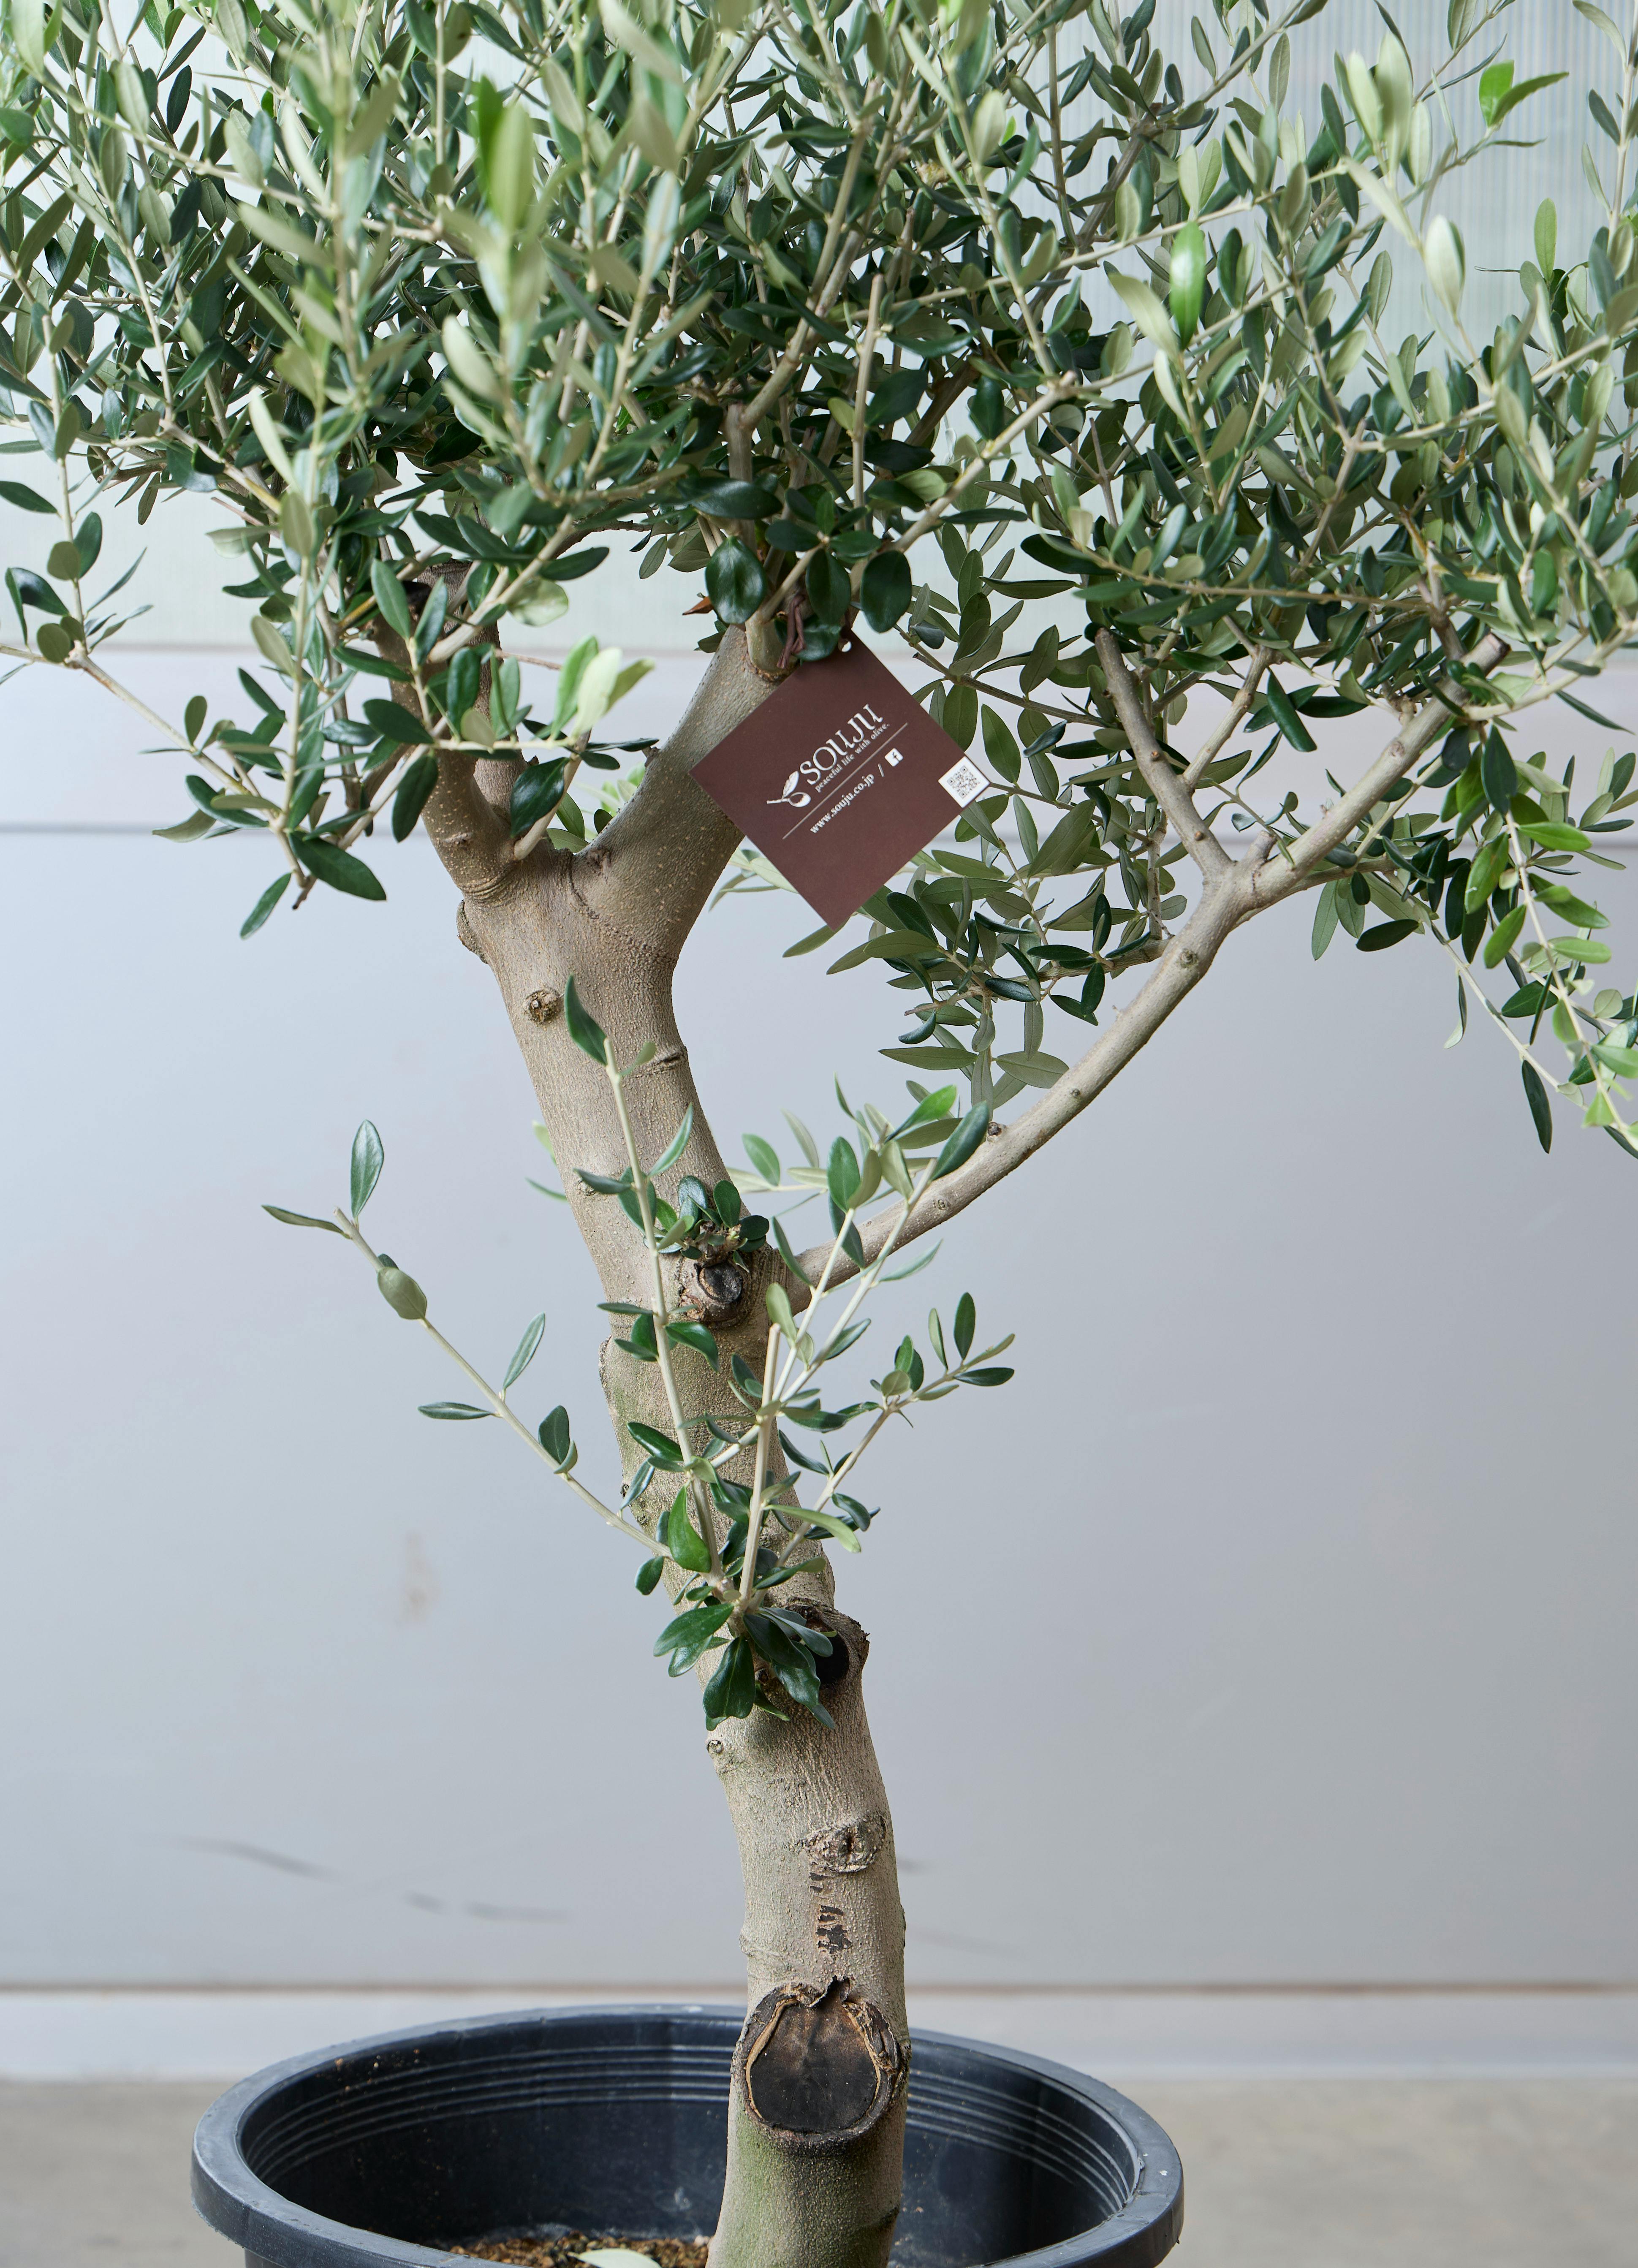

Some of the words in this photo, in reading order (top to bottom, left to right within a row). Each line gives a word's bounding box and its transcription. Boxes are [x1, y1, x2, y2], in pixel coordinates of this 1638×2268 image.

[815, 763, 843, 793] peaceful
[841, 754, 855, 766] life
[855, 739, 871, 754] with
[871, 723, 890, 740] olive.
[810, 774, 875, 834] www.souju.co.jp
